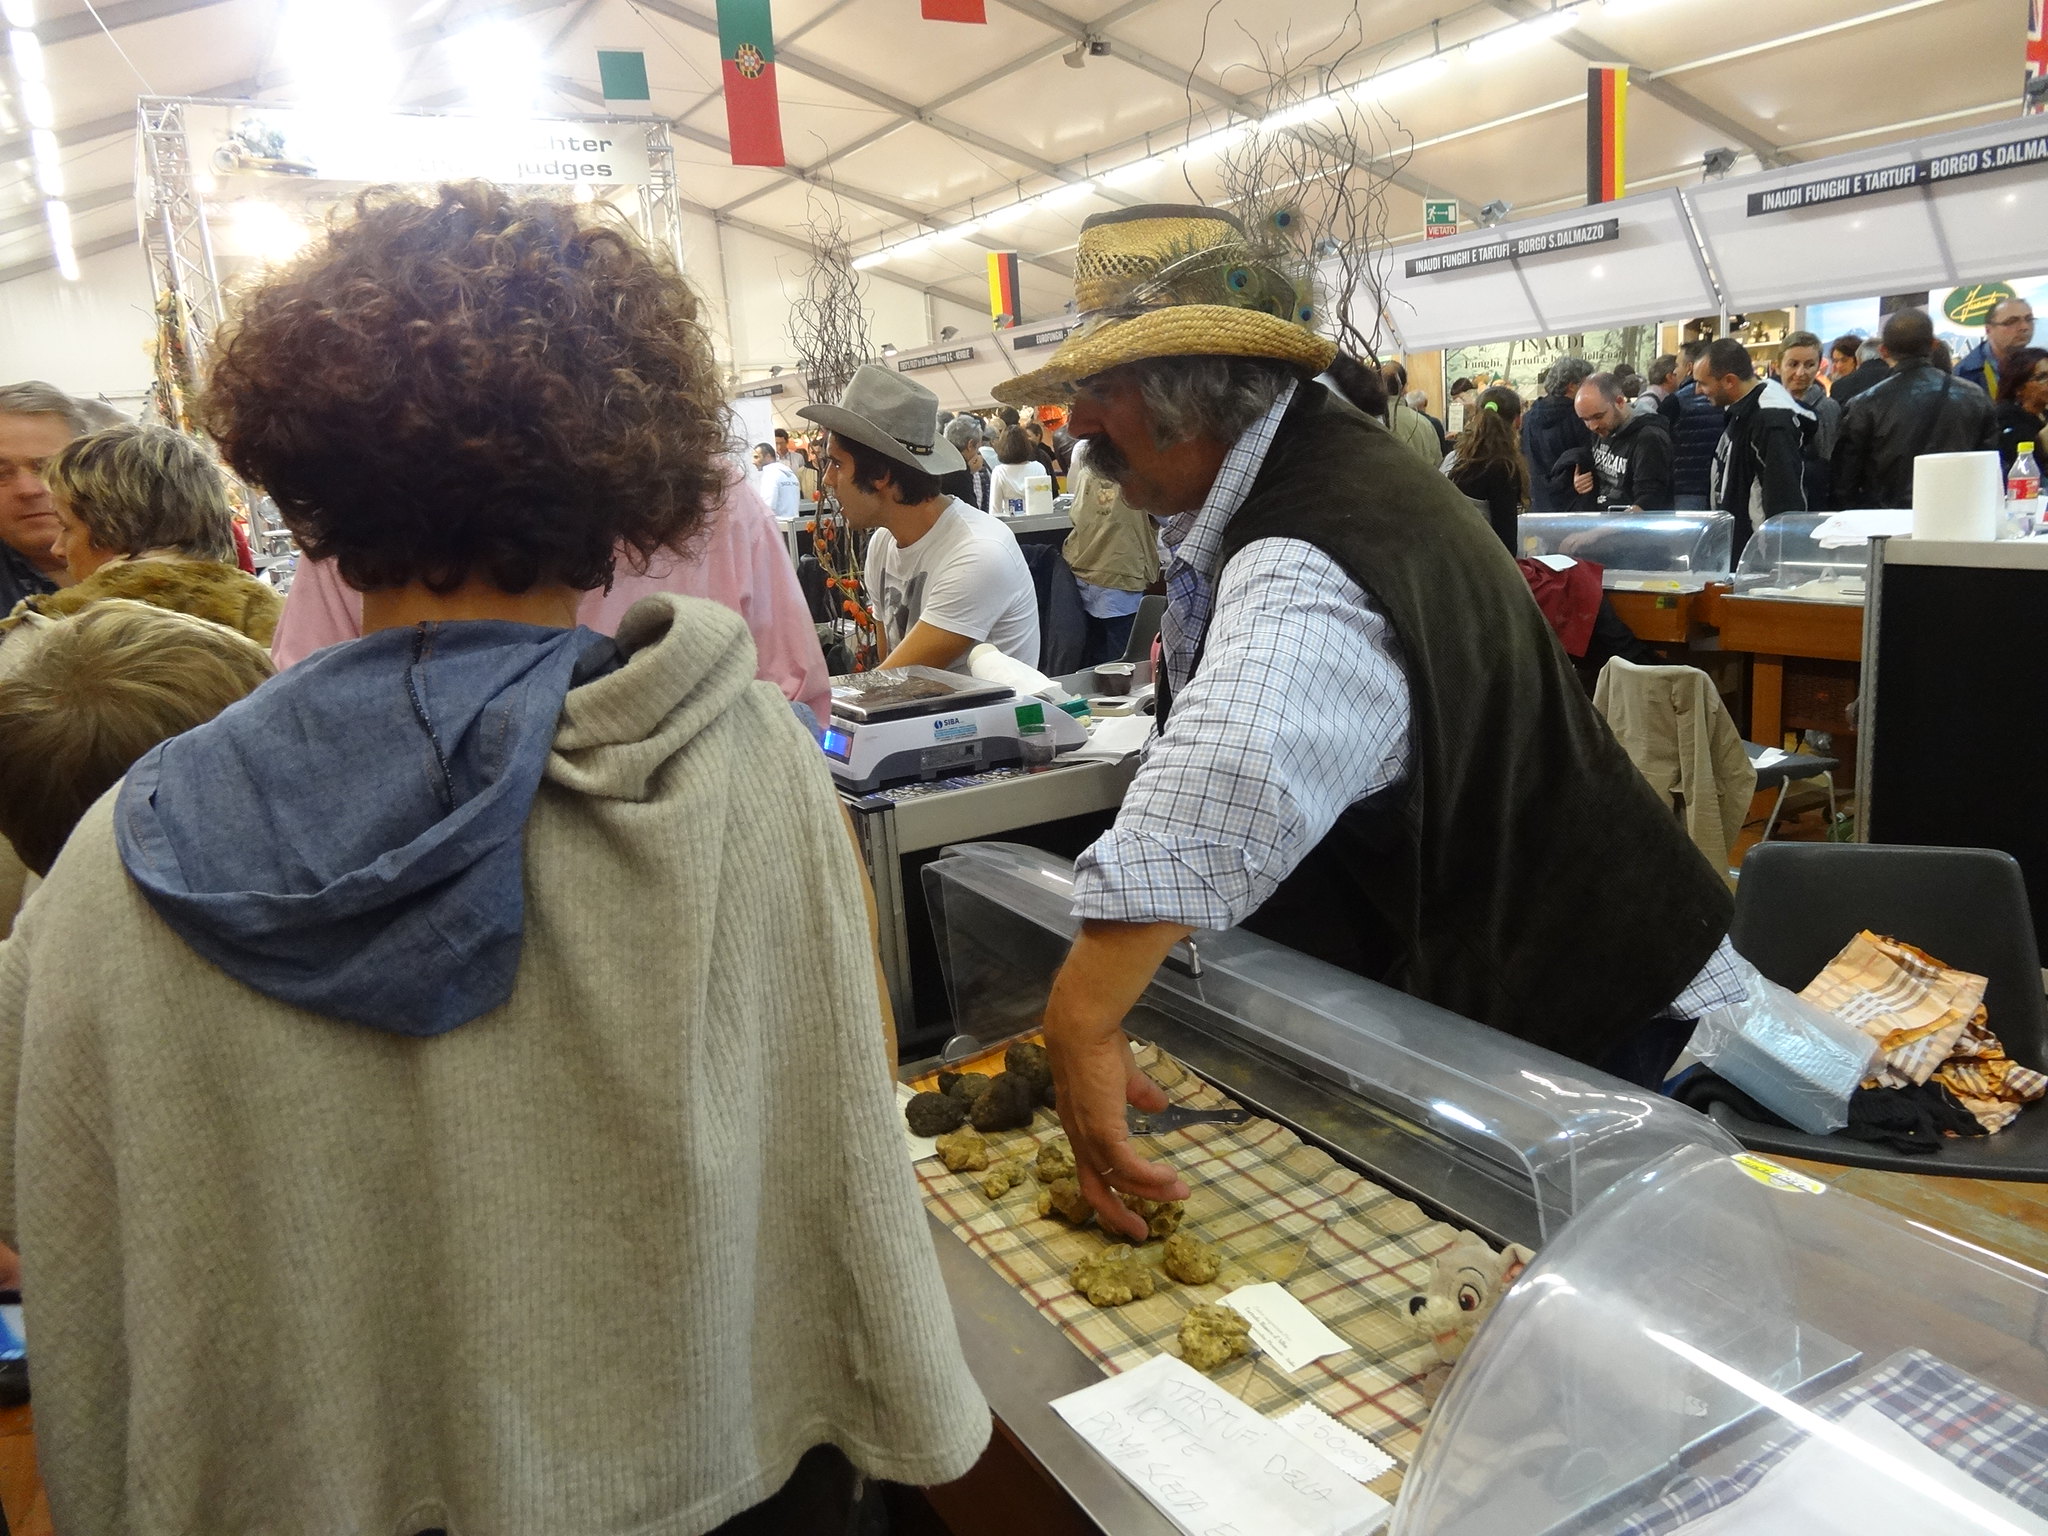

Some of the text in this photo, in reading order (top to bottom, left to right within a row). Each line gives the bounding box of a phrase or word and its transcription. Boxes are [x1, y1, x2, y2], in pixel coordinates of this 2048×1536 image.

[517, 160, 613, 180] judges
[1762, 187, 1802, 211] INAUDI
[1805, 177, 1850, 203] FUNGHI
[1853, 178, 1861, 194] E
[1864, 165, 1916, 191] TARTUFI
[1931, 151, 1979, 179] BORGO
[1981, 137, 2048, 169] S.DALMA
[1428, 226, 1456, 235] VIETATO
[1415, 258, 1441, 273] INAUDI
[1442, 252, 1470, 268] FUNGHI
[1471, 250, 1477, 262] E
[1479, 243, 1510, 261] TARTUFI
[1518, 236, 1547, 254] BORGO
[1548, 224, 1604, 248] S.DALMAZZO
[1521, 334, 1585, 352] INAUDI
[944, 718, 960, 726] SIBA
